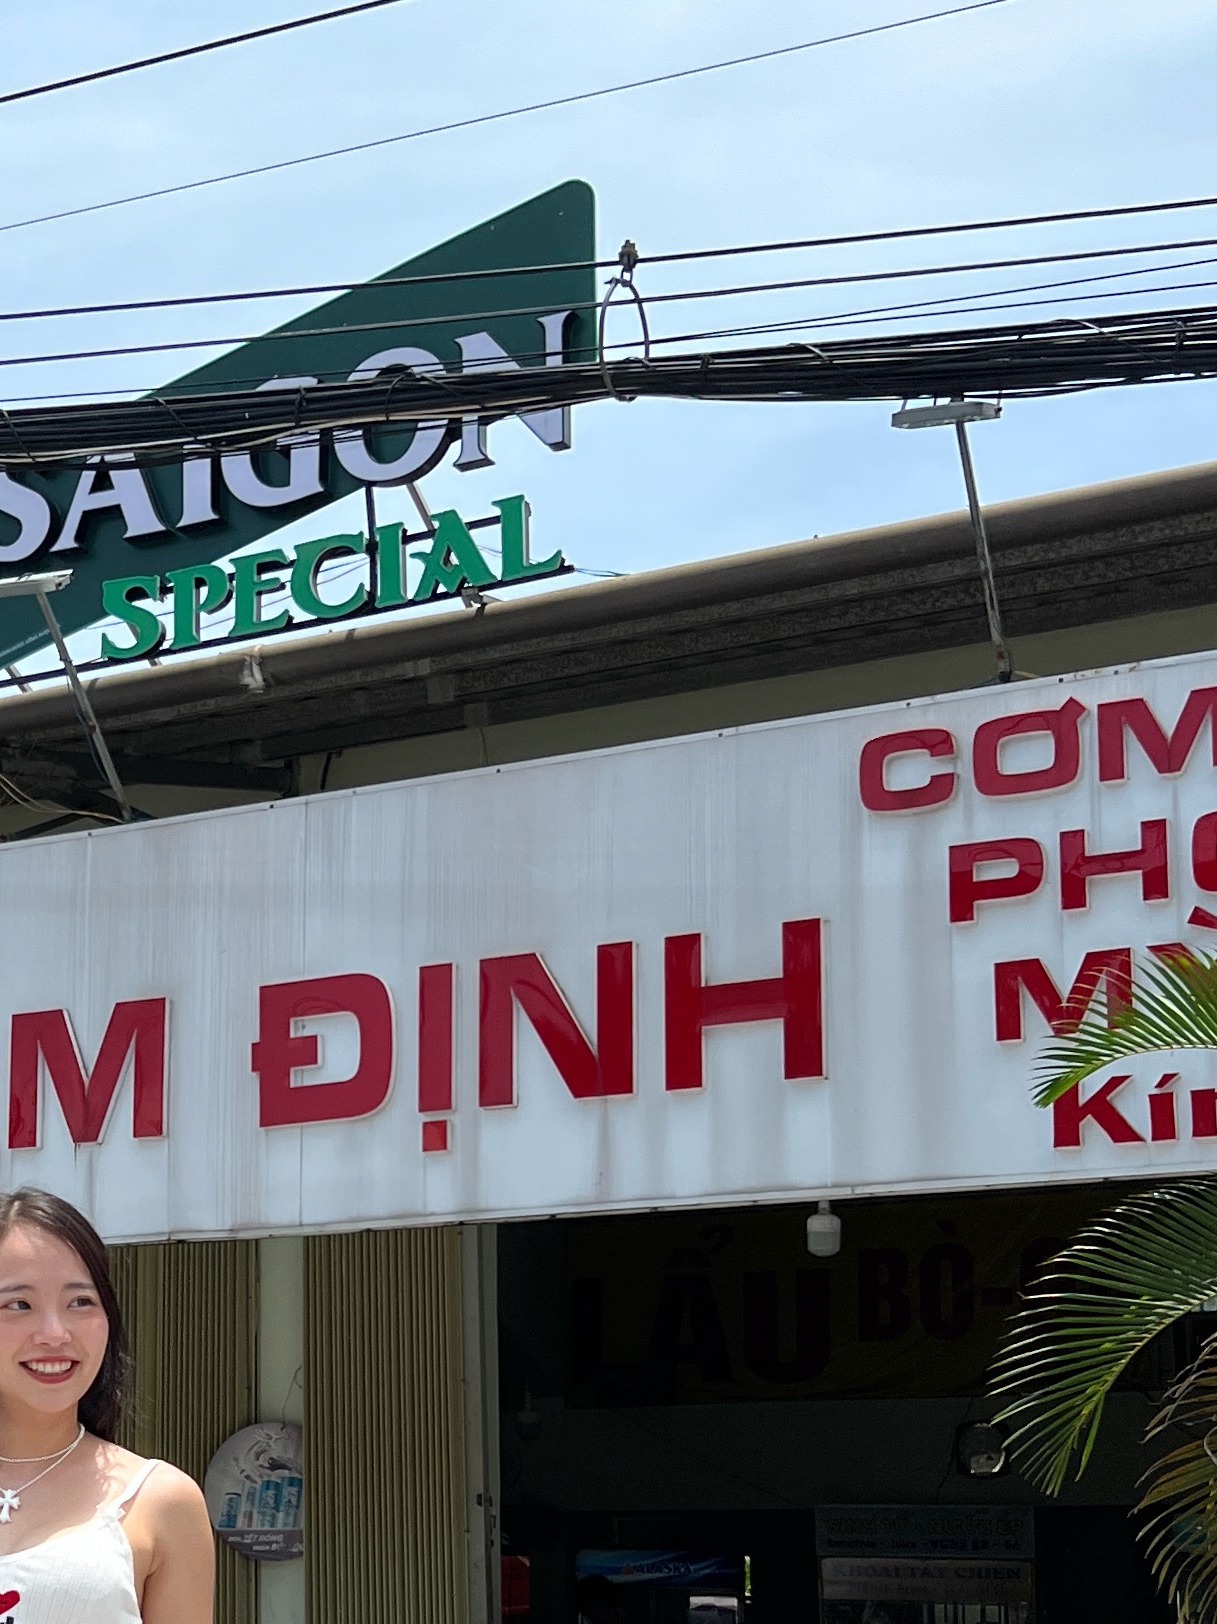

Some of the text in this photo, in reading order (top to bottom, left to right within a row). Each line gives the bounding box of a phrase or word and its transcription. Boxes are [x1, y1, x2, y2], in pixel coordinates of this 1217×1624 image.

[101, 494, 564, 659] SPECIAL
[859, 686, 1217, 813] CƠM
[251, 917, 824, 1153] ĐỊNH
